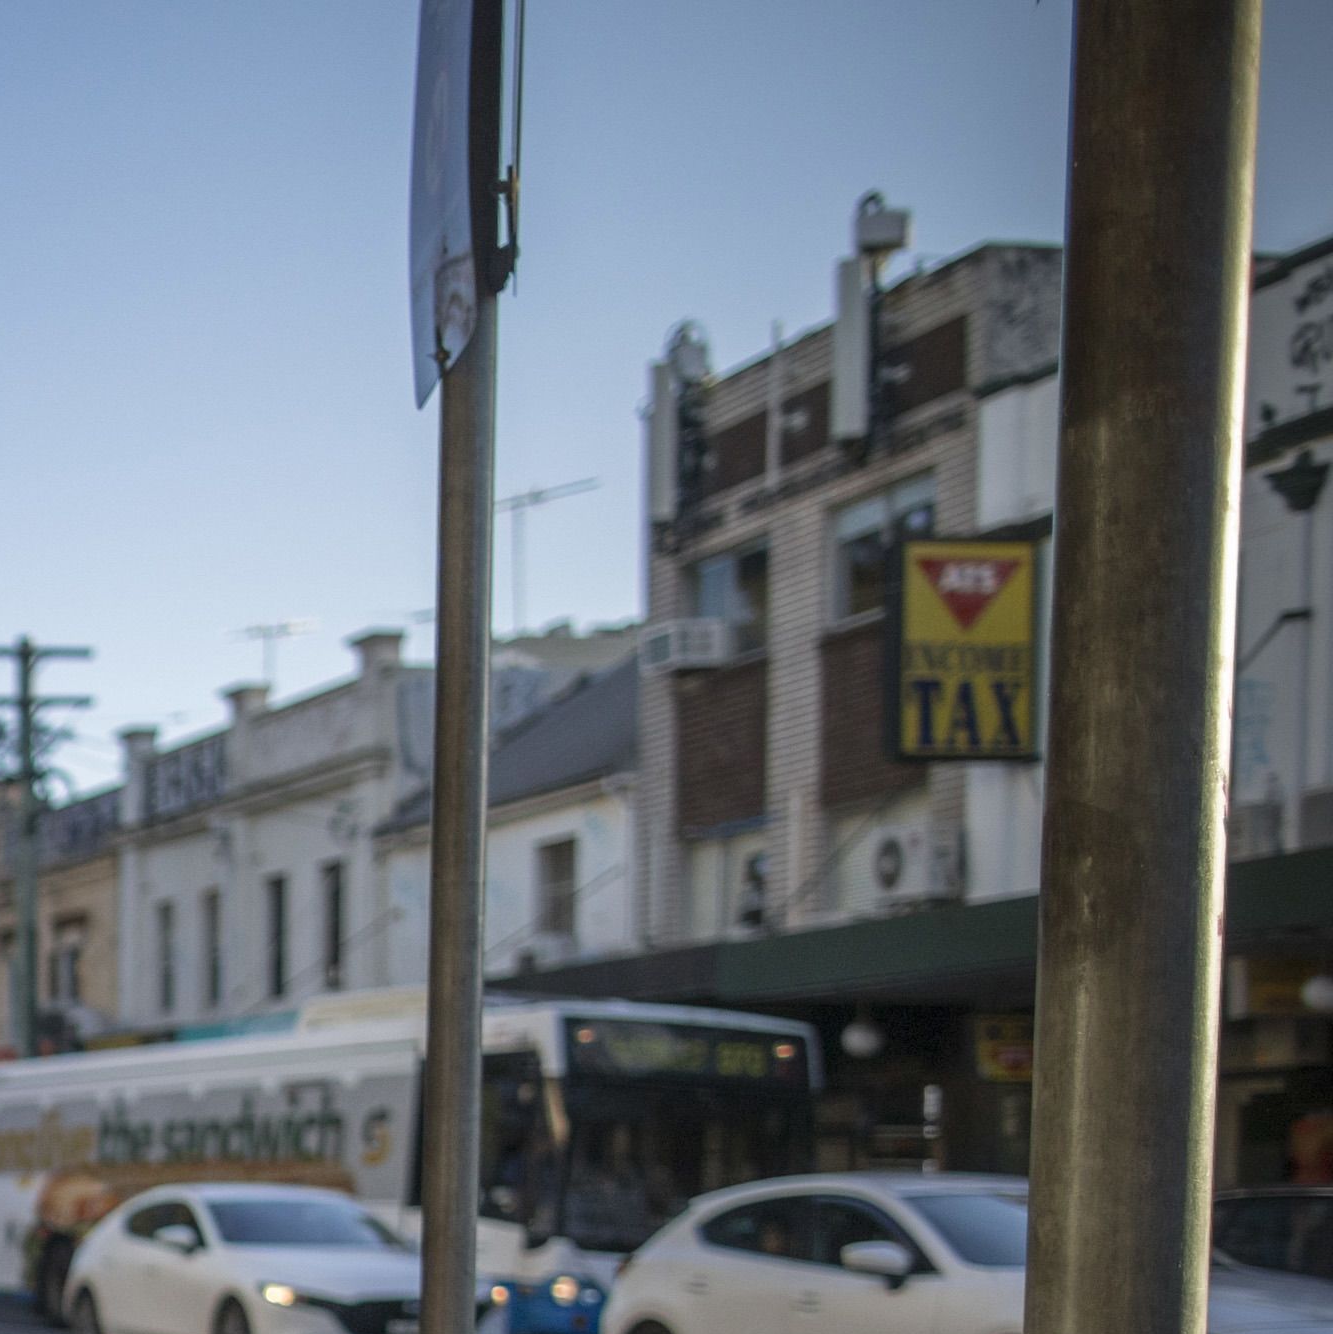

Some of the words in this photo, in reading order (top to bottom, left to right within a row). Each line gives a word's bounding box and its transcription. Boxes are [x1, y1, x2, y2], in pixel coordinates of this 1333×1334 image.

[907, 679, 1023, 749] TAX
[96, 1099, 150, 1165] the
[161, 1081, 344, 1164] sandwich
